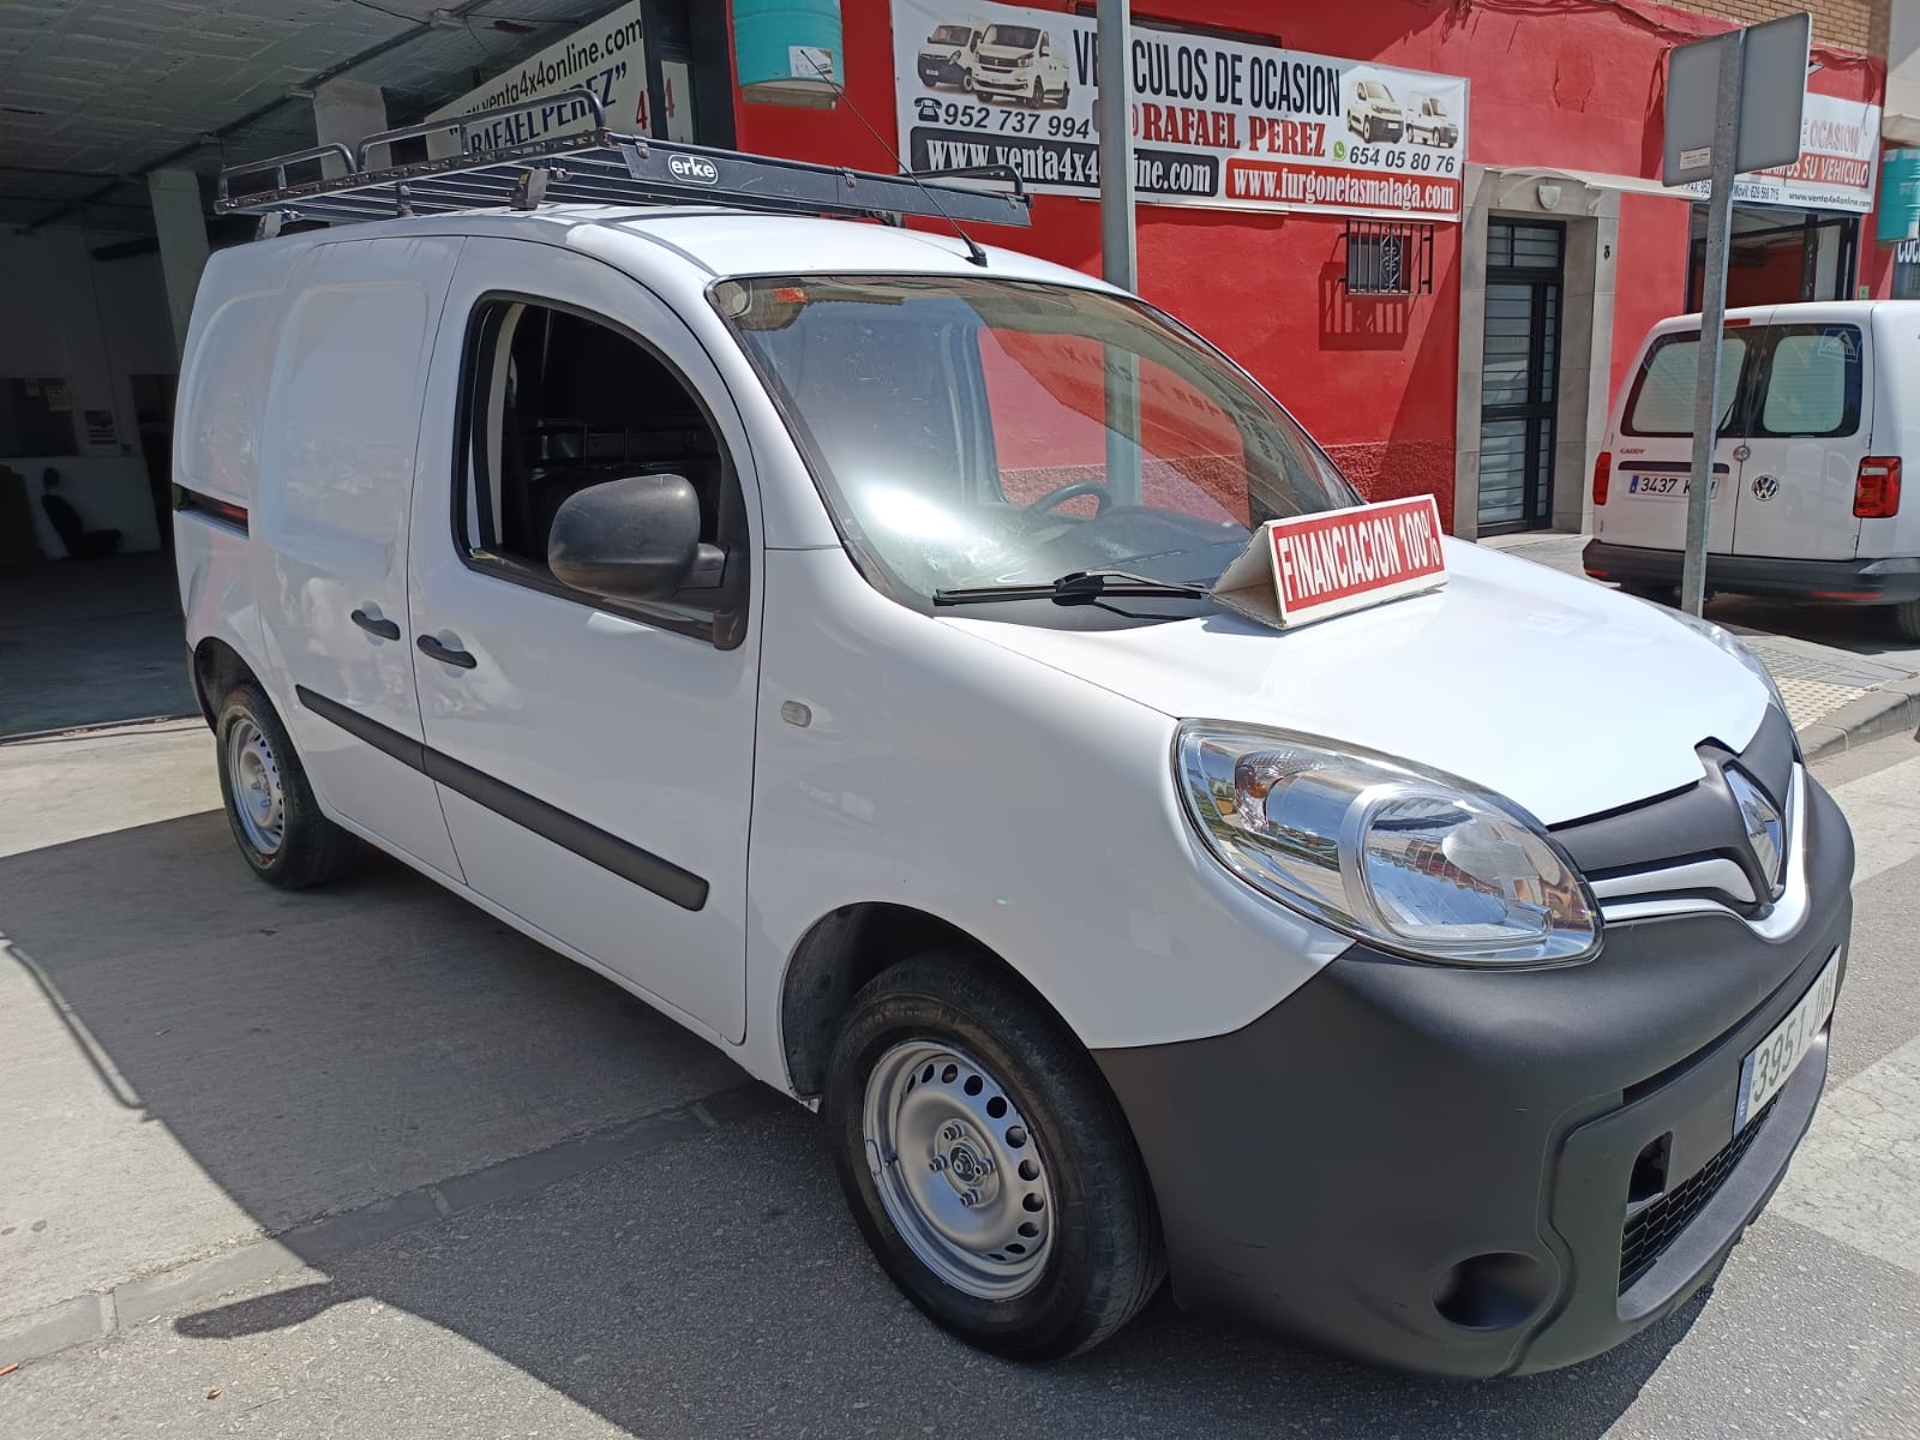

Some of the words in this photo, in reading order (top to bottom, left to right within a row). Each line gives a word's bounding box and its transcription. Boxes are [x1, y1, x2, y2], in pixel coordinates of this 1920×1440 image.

[1073, 29, 1208, 102] VECULOS
[1215, 51, 1243, 107] DE
[1250, 56, 1340, 117] OCASION
[943, 103, 990, 130] 952
[999, 109, 1041, 135] 737
[1048, 115, 1089, 139] 994
[1142, 102, 1240, 150] RAFAEL
[1248, 115, 1326, 158] PEREZ
[1809, 119, 1860, 154] OCASION
[671, 157, 715, 177] erke
[926, 139, 1211, 193] www.venta4x4ine.com
[1350, 146, 1380, 166] 654
[1385, 149, 1405, 169] 05
[1410, 152, 1431, 172] 80
[1436, 155, 1455, 174] 76
[1803, 155, 1819, 180] SU
[1822, 157, 1869, 186] VEHICULO
[1233, 167, 1454, 211] www.furgonetasmalaga.com
[1641, 477, 1677, 494] 3437
[1278, 516, 1402, 603] FINANCIACION
[1398, 508, 1441, 571] 100%
